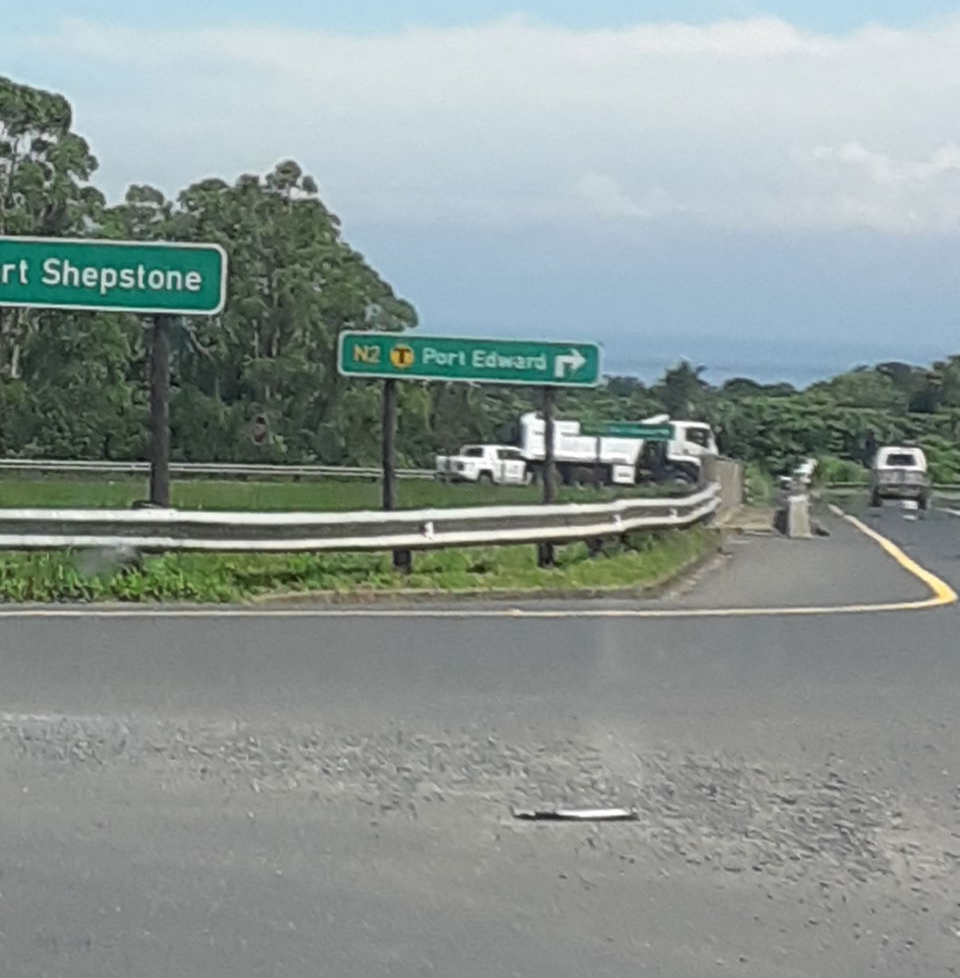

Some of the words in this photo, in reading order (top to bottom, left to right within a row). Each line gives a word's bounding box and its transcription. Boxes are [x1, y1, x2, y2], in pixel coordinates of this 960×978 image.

[41, 258, 203, 295] Shepstone
[353, 344, 381, 364] N2
[392, 347, 413, 365] T
[422, 347, 466, 366] Port
[471, 350, 547, 371] Edward
